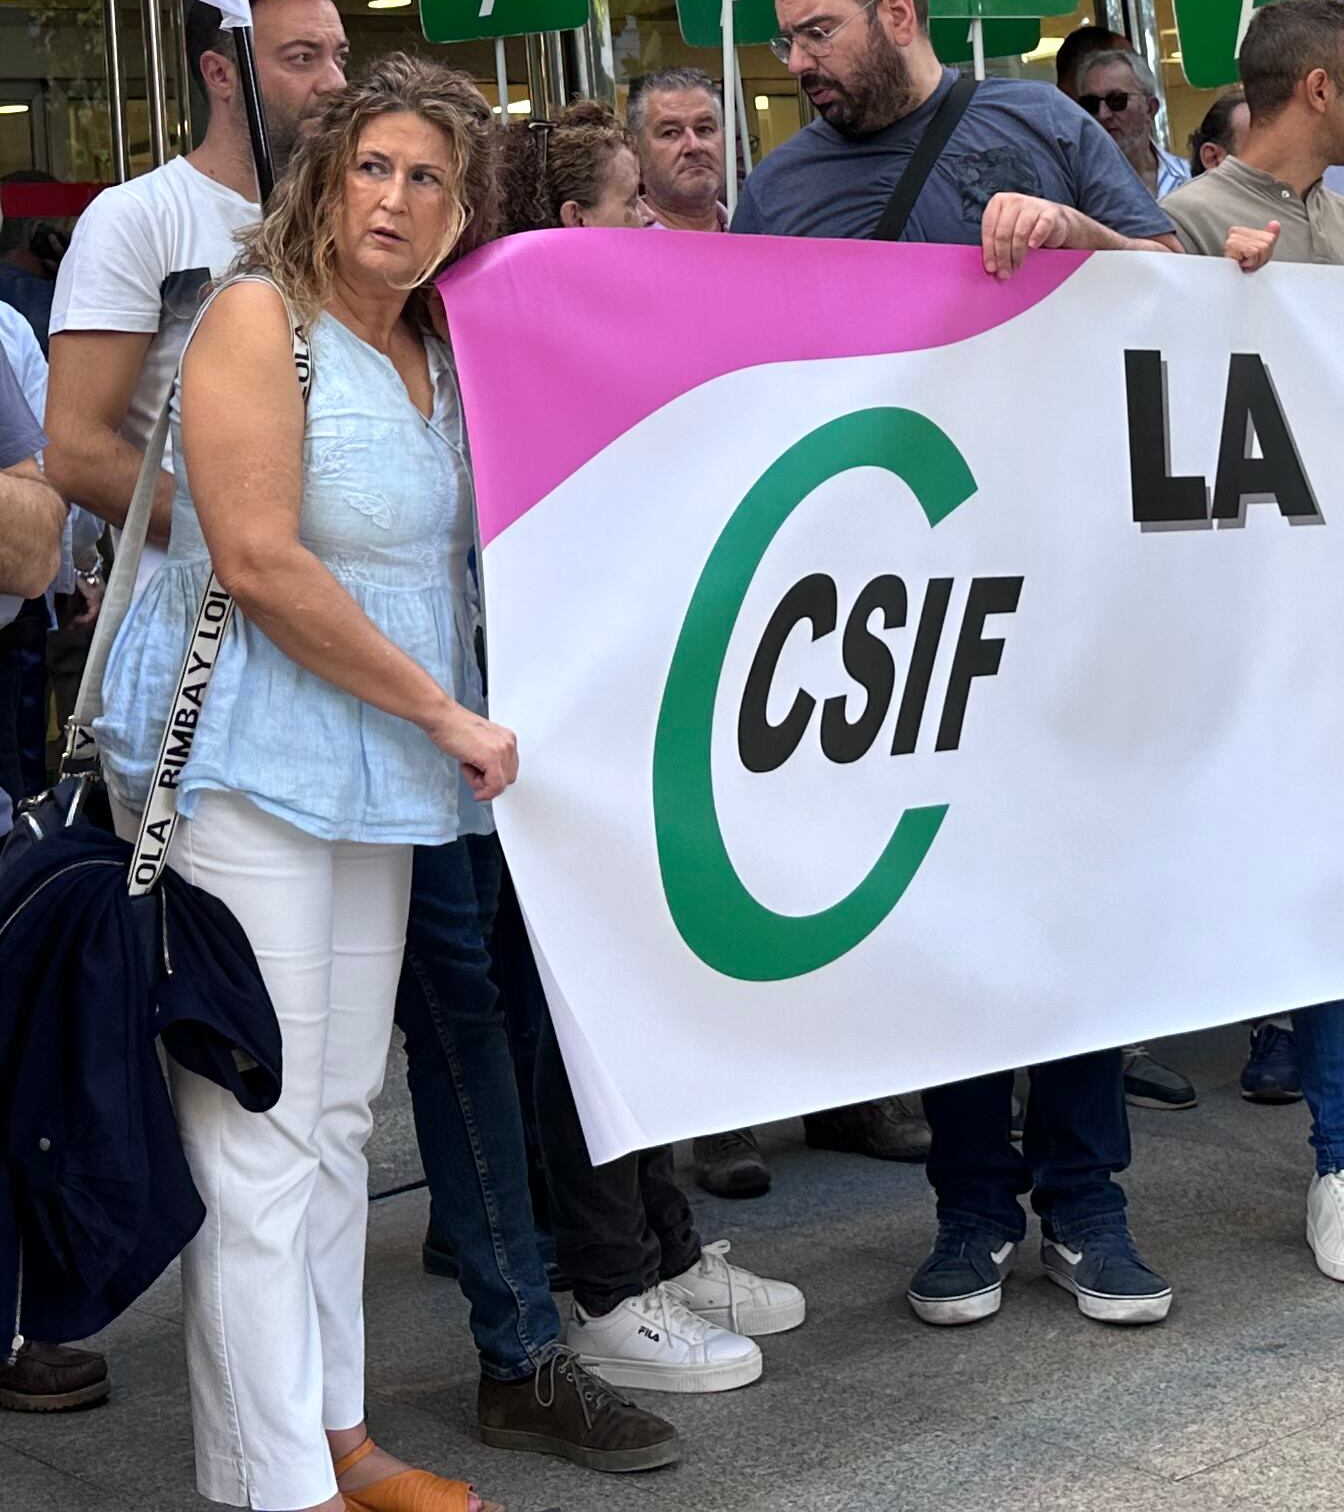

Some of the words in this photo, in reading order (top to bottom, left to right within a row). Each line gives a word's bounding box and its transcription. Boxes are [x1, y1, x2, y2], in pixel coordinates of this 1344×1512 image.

[1123, 347, 1325, 533] LA
[737, 572, 1026, 773] CSIF
[638, 1325, 660, 1343] FILA
